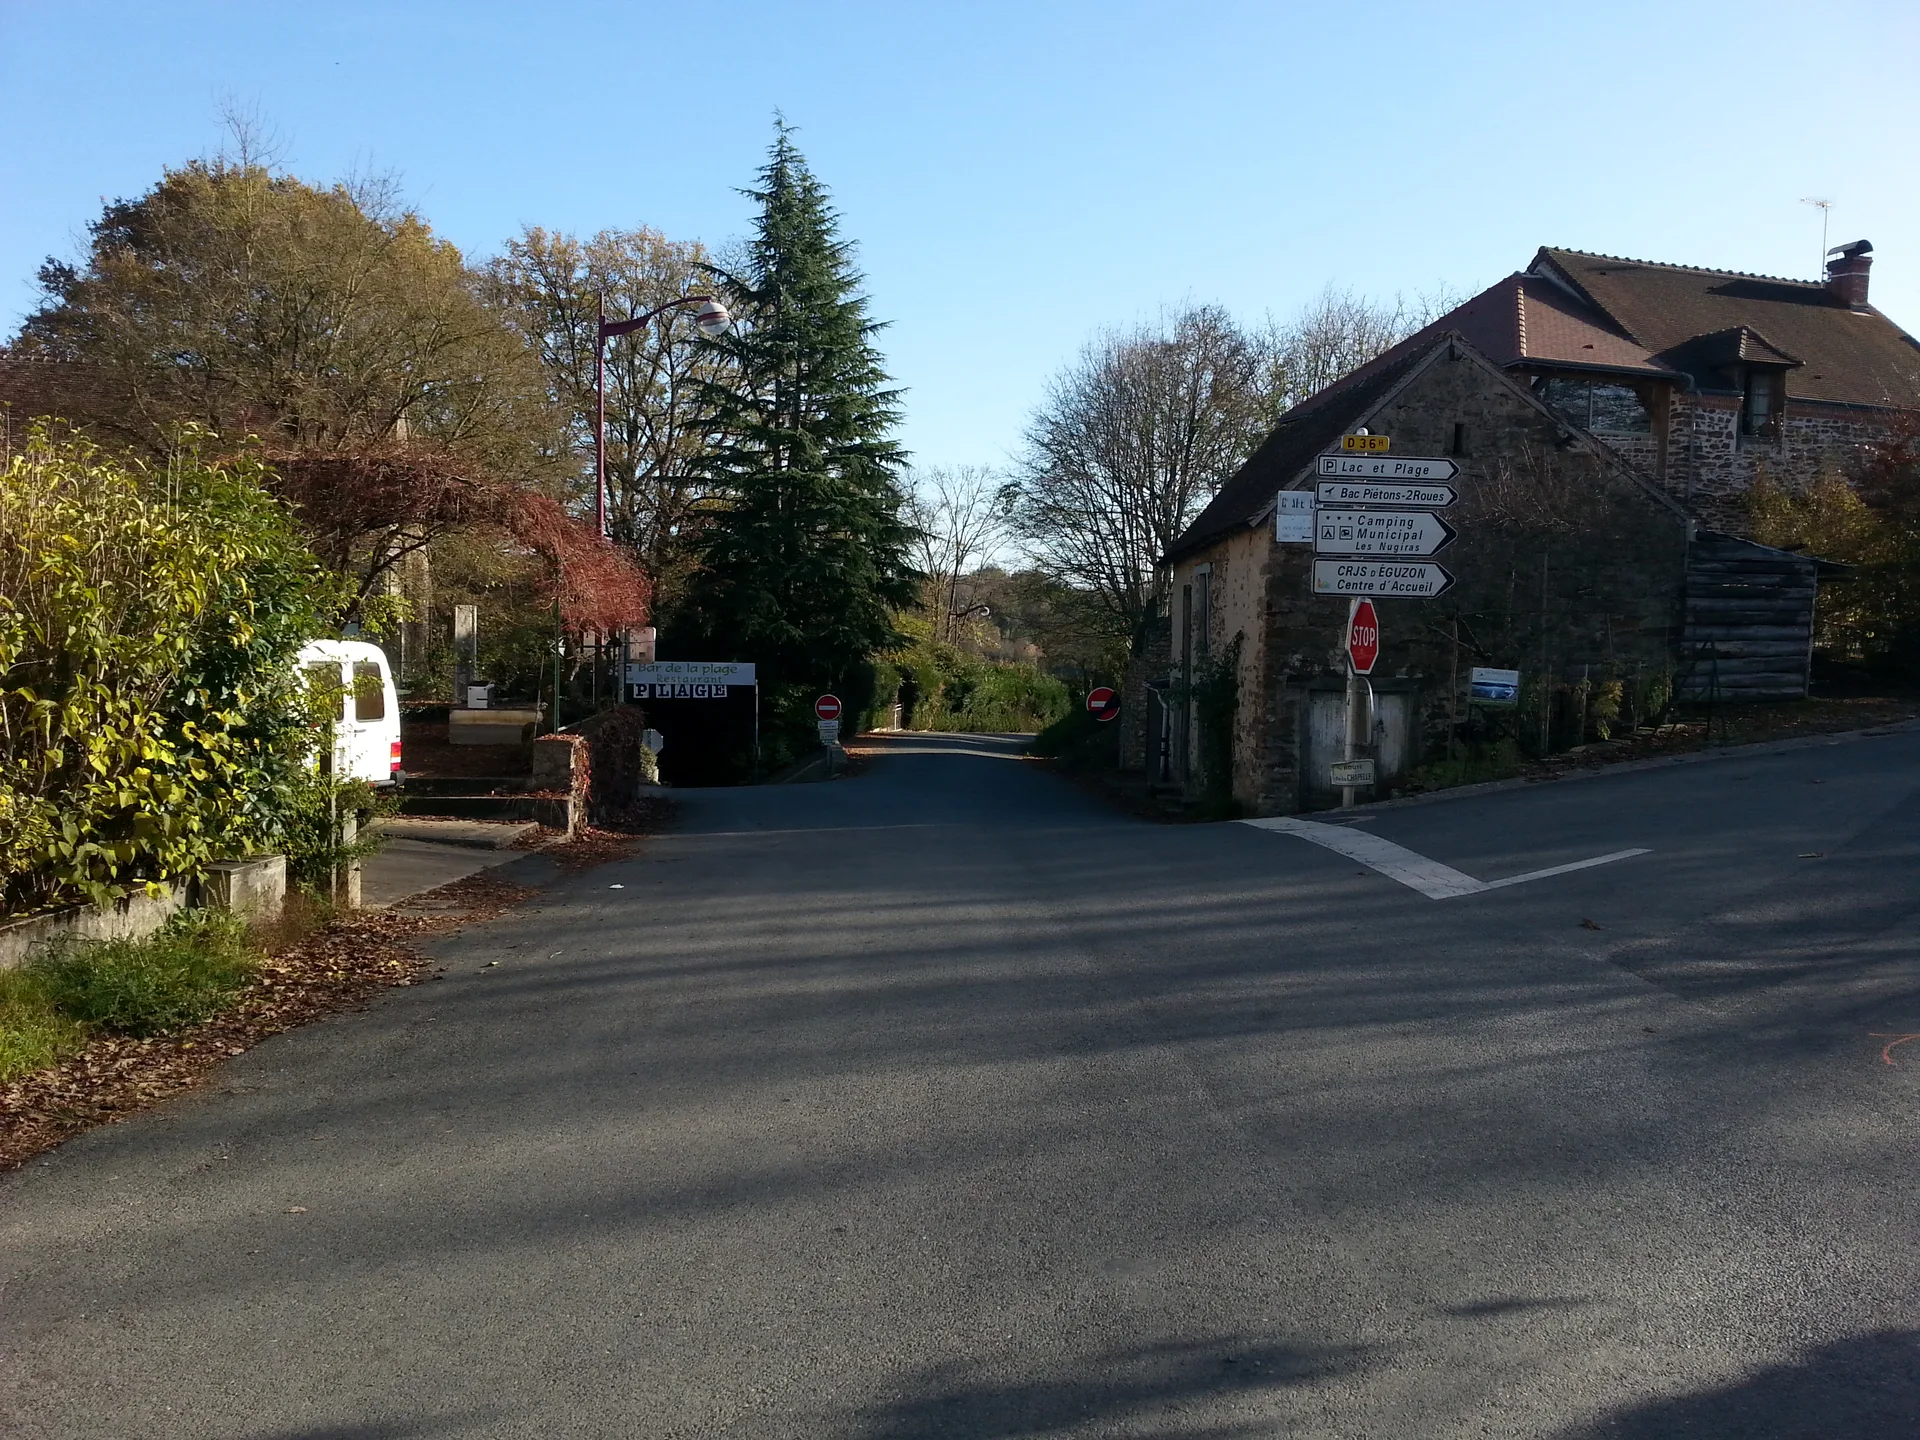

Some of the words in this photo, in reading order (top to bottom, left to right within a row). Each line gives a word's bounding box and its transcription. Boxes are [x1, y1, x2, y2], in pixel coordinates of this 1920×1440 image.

[1347, 438, 1355, 448] D
[1341, 462, 1363, 473] Lac
[1373, 464, 1385, 474] et
[1394, 464, 1430, 477] Plage
[1340, 488, 1360, 499] Bac
[1357, 515, 1414, 529] Camping
[1356, 528, 1423, 542] Municipal
[1355, 541, 1372, 551] Les
[1379, 542, 1420, 553] Nugiras
[1337, 565, 1368, 578] CRJS
[1337, 579, 1374, 591] Centre
[1379, 580, 1433, 593] d'Accueil
[1352, 625, 1376, 647] STOP
[638, 663, 661, 673] Bar
[665, 663, 682, 673] de
[687, 663, 698, 673] la
[702, 664, 738, 676] plage
[656, 674, 723, 684] Restaurant
[635, 684, 727, 697] PLAGE
